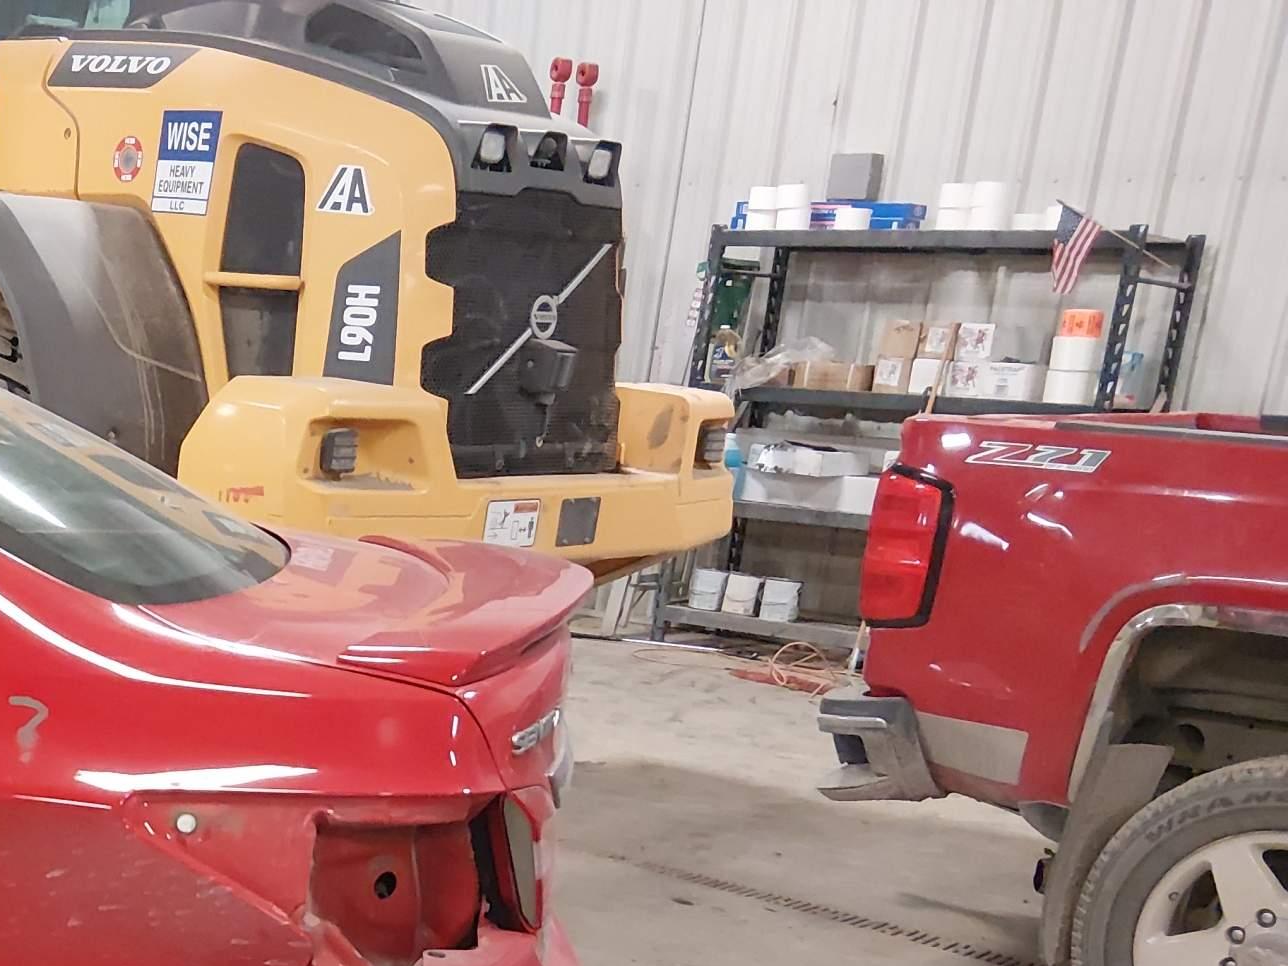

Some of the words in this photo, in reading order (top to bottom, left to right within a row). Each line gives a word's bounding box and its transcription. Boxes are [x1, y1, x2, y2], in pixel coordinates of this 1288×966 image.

[71, 54, 171, 75] VOLVO
[167, 121, 213, 151] WISE
[169, 165, 196, 178] HEAVY
[158, 181, 204, 194] EQUIPMENT
[169, 200, 185, 211] LLC
[338, 284, 381, 362] L90H
[965, 441, 1112, 472] Z71
